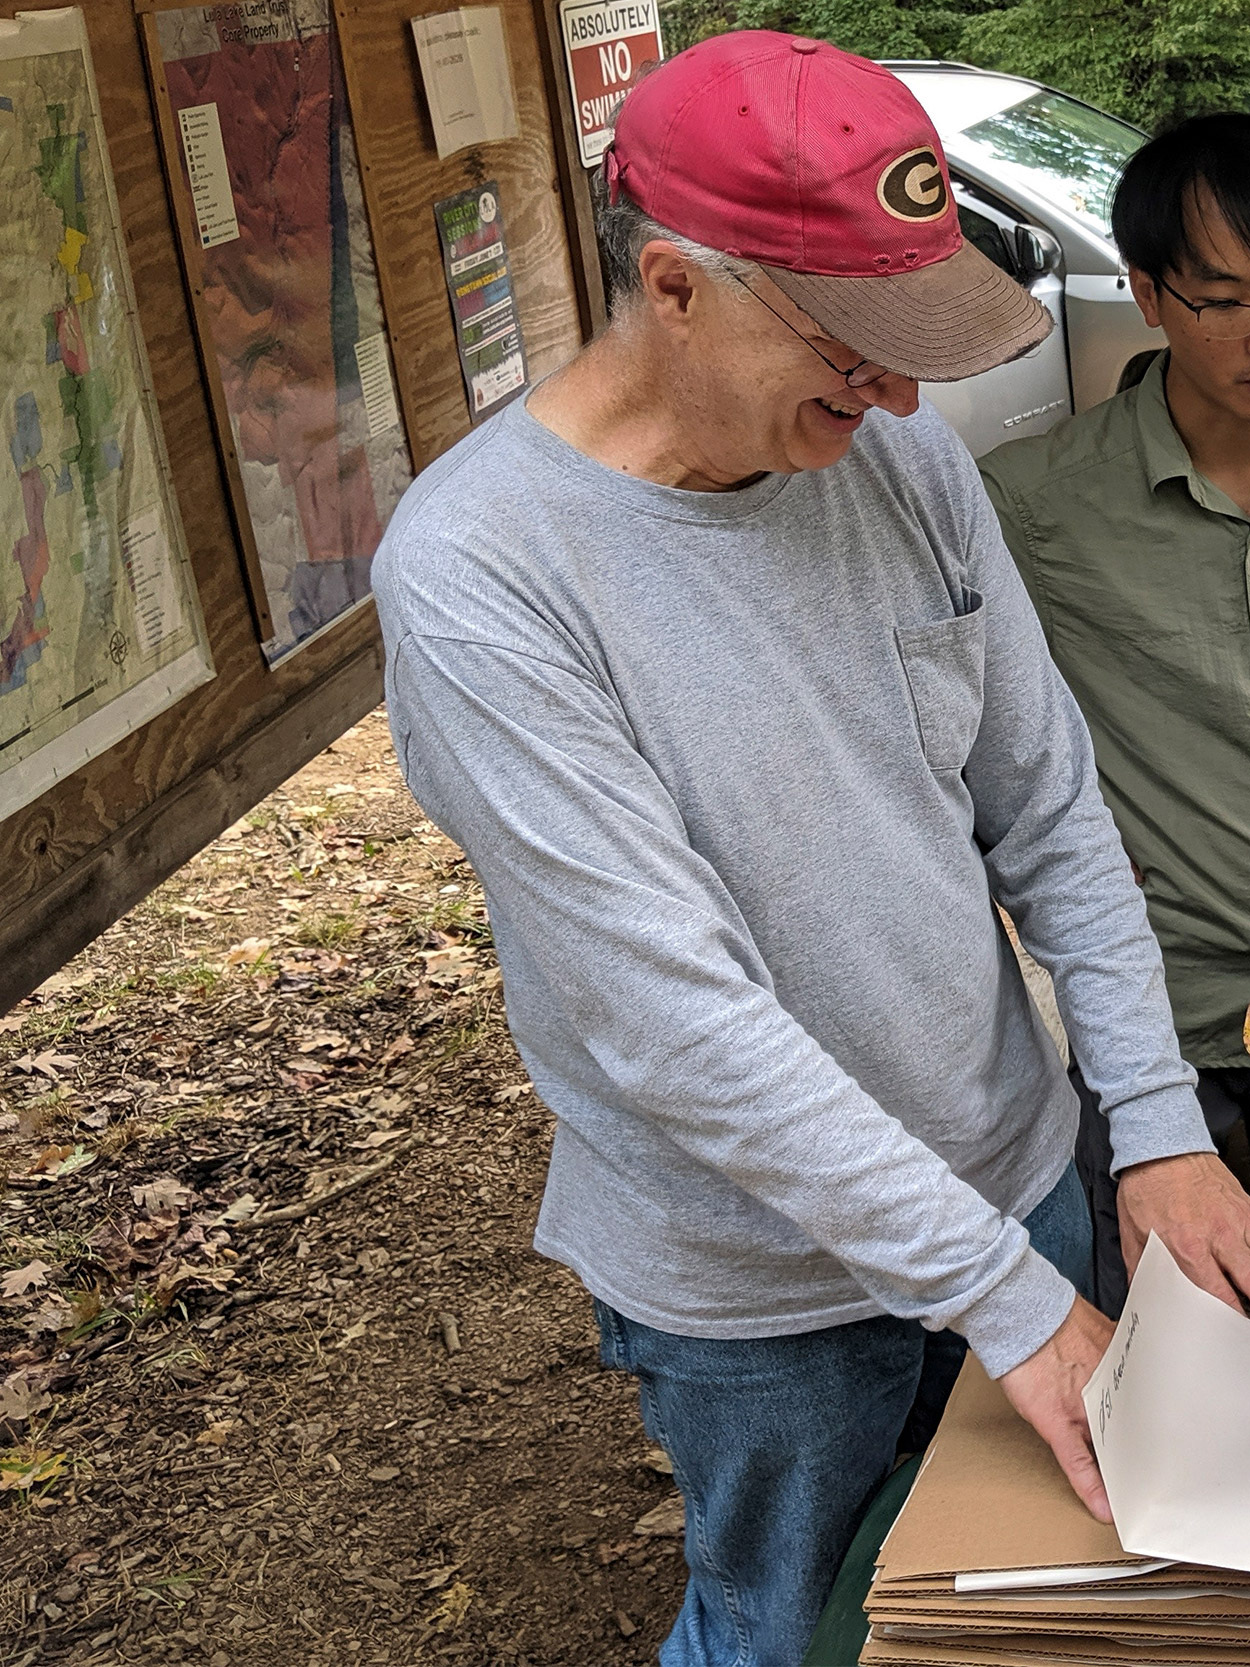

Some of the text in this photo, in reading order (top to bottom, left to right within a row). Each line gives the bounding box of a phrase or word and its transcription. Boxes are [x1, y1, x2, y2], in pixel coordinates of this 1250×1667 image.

[223, 5, 244, 20] Lake
[245, 2, 266, 17] Land
[267, 0, 290, 14] Trust
[571, 4, 651, 42] ABSOLUTELY
[221, 22, 280, 43] Core Property
[598, 41, 632, 87] NO
[883, 150, 947, 218] G
